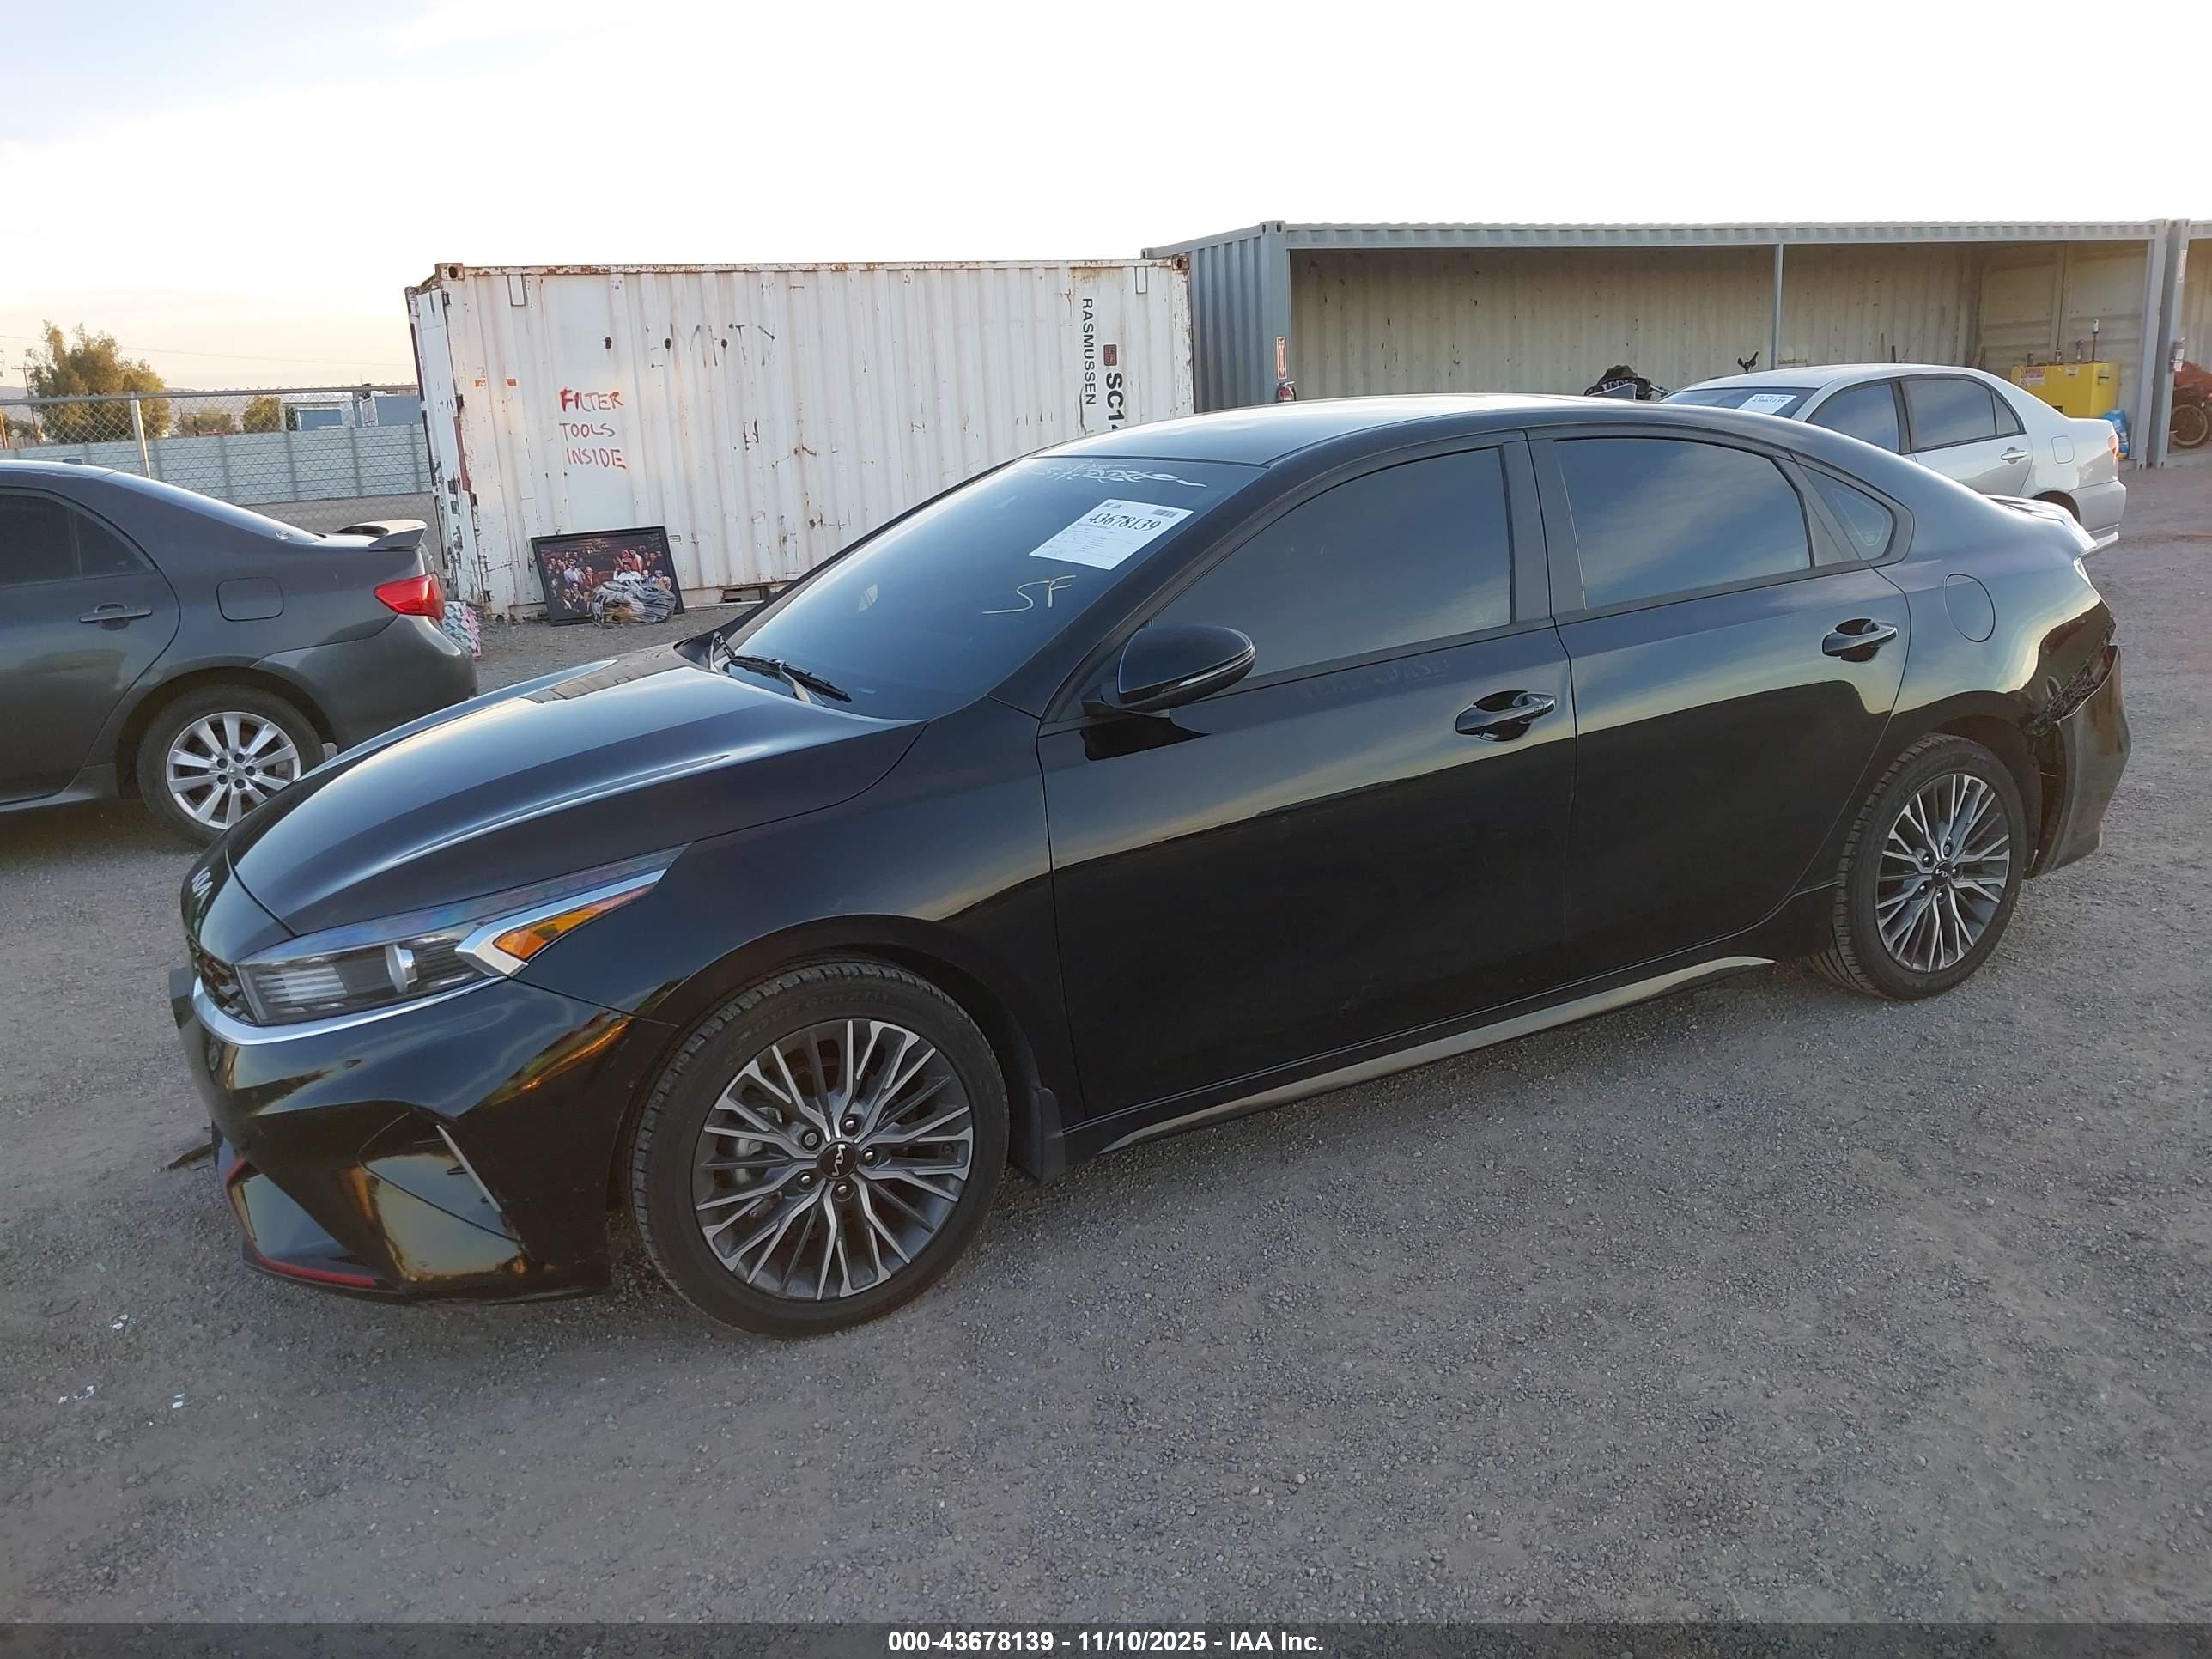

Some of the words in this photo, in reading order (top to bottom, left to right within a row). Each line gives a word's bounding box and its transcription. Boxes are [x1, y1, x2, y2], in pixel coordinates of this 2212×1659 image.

[1082, 298, 1097, 405] RASMUSSEN
[560, 388, 624, 412] FILTER
[1105, 372, 1125, 429] SC1
[558, 422, 616, 442] TOOLS
[566, 447, 627, 469] INSIDE
[1089, 513, 1163, 531] 43678139
[981, 574, 1076, 615] SF
